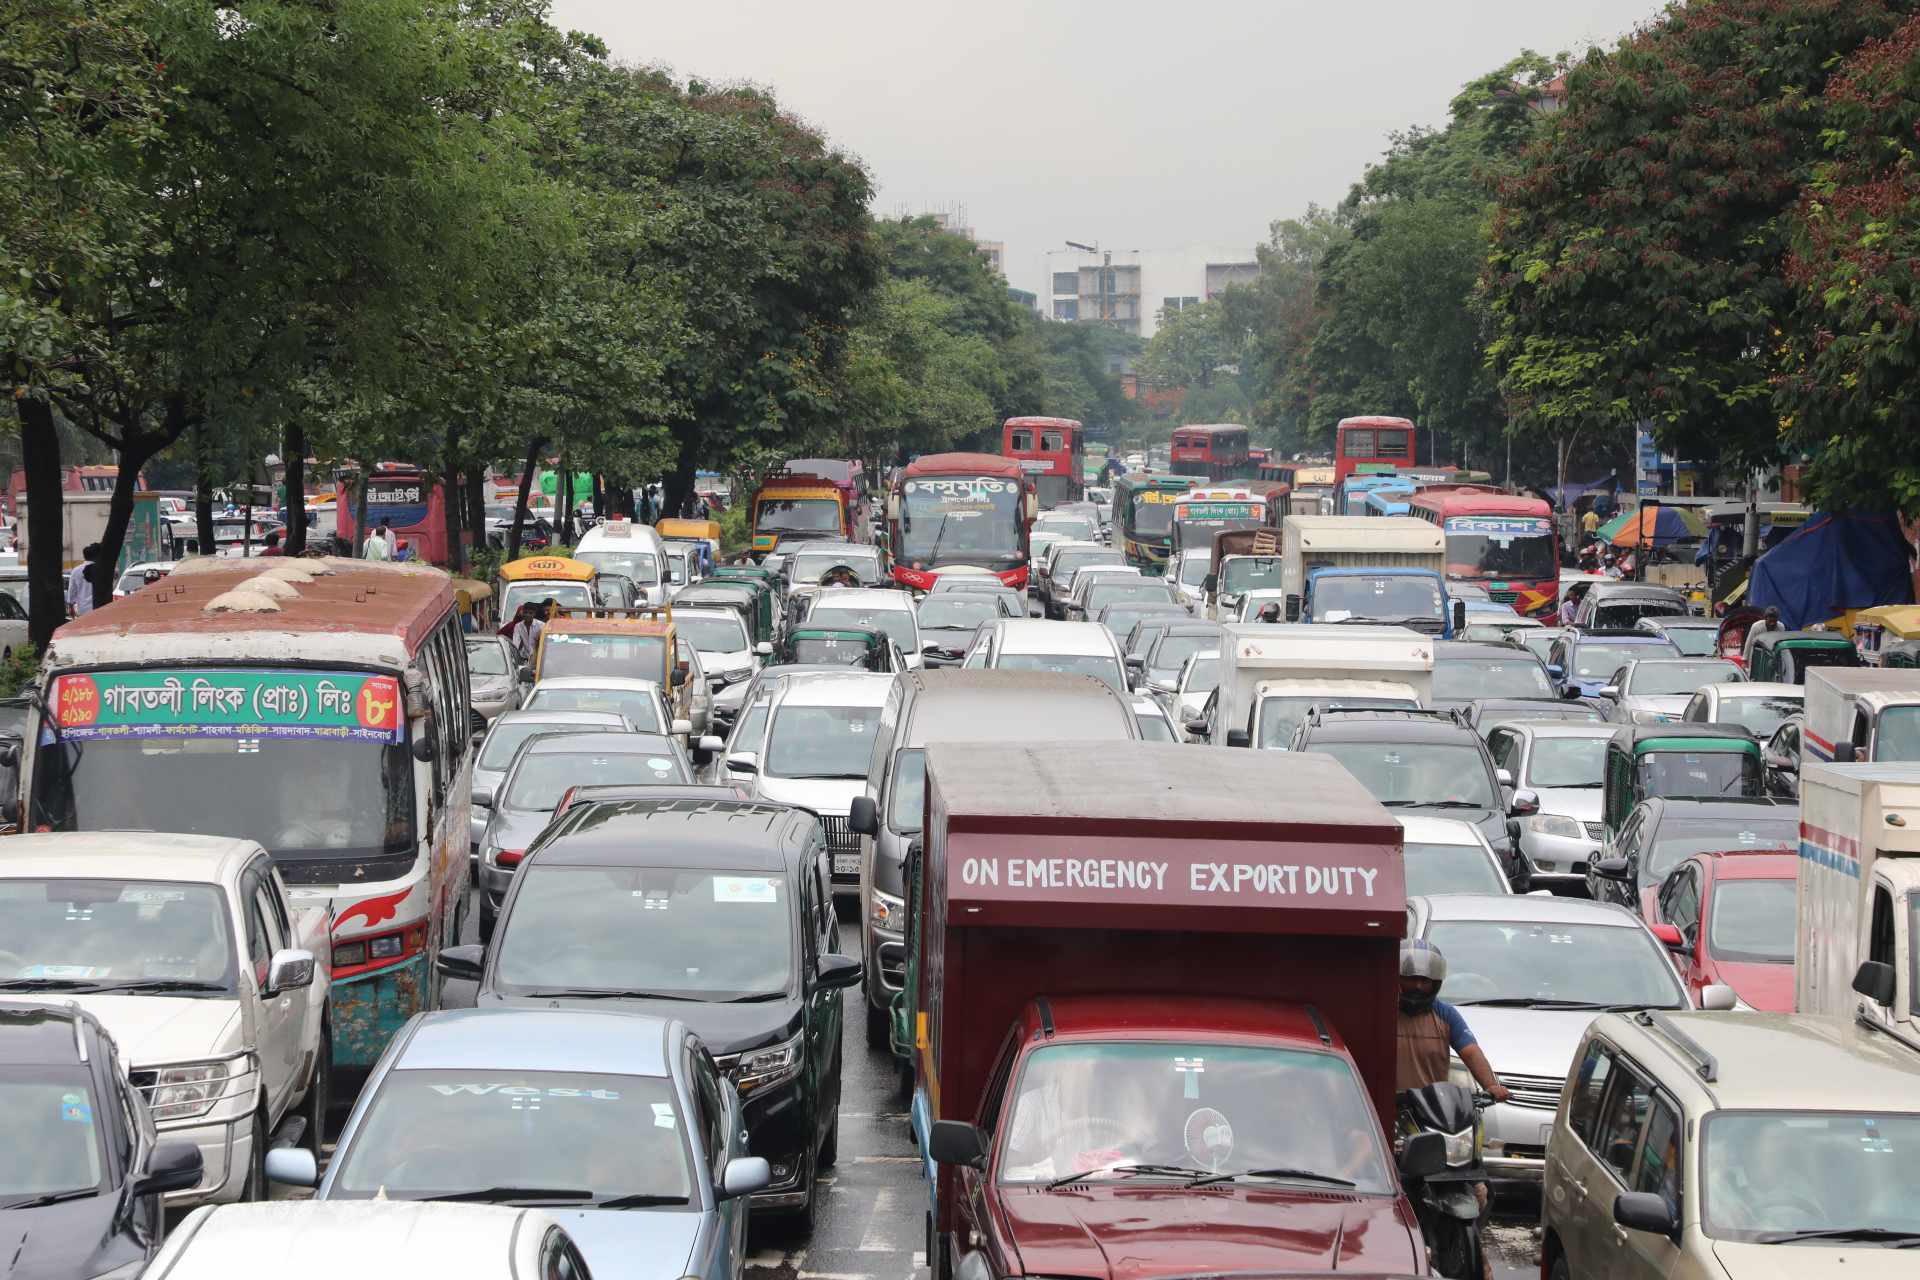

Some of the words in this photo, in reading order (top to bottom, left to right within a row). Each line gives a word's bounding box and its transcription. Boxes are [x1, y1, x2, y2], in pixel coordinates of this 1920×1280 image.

[916, 477, 1006, 496] বসুমতি
[1446, 518, 1535, 531] বিকাশ
[104, 676, 185, 715] গাবতলী
[190, 678, 247, 715] লিংক
[253, 683, 309, 720] (প্রাঃ)
[316, 680, 352, 715] লিঃ
[363, 688, 393, 725] ৮
[962, 858, 999, 885] ON
[1007, 858, 1169, 890] EMERGENCY
[1190, 862, 1300, 894] EXPORT
[1305, 865, 1378, 897] DUTY
